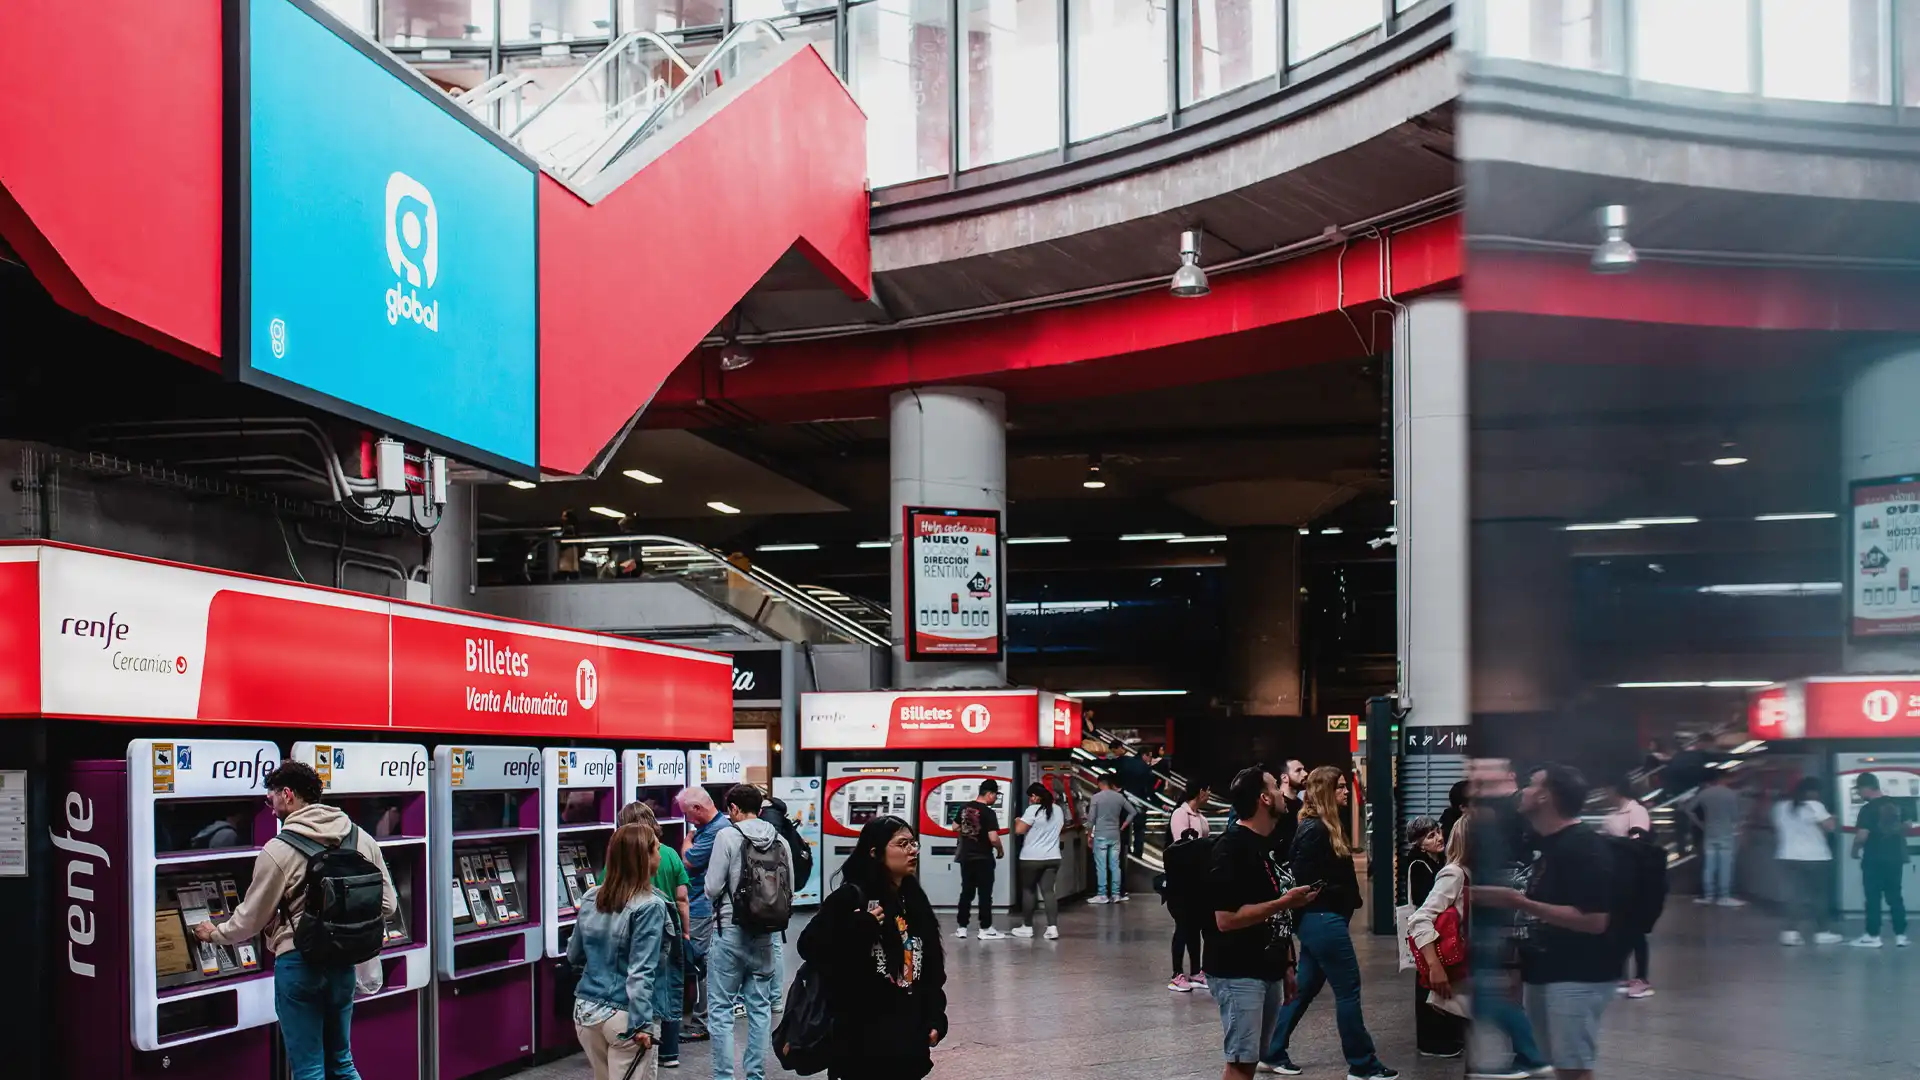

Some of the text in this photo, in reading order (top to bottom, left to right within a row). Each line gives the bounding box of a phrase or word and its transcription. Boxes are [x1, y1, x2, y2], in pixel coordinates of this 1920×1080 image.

[386, 282, 438, 332] global
[922, 535, 969, 545] NUEVO
[924, 556, 969, 565] DIRECCIÓN
[924, 565, 969, 579] RENTING
[61, 612, 129, 650] renfe
[112, 651, 173, 674] Cercanías
[465, 638, 529, 678] Billetes
[465, 686, 568, 716] Venta Automática
[900, 705, 953, 720] Billetes
[212, 748, 275, 789] renfe
[381, 751, 426, 786] renfe
[503, 753, 540, 784] renfe
[584, 755, 614, 782] renfe
[658, 755, 684, 780] renfe
[718, 756, 741, 779] renfe
[49, 791, 110, 977] renfe
